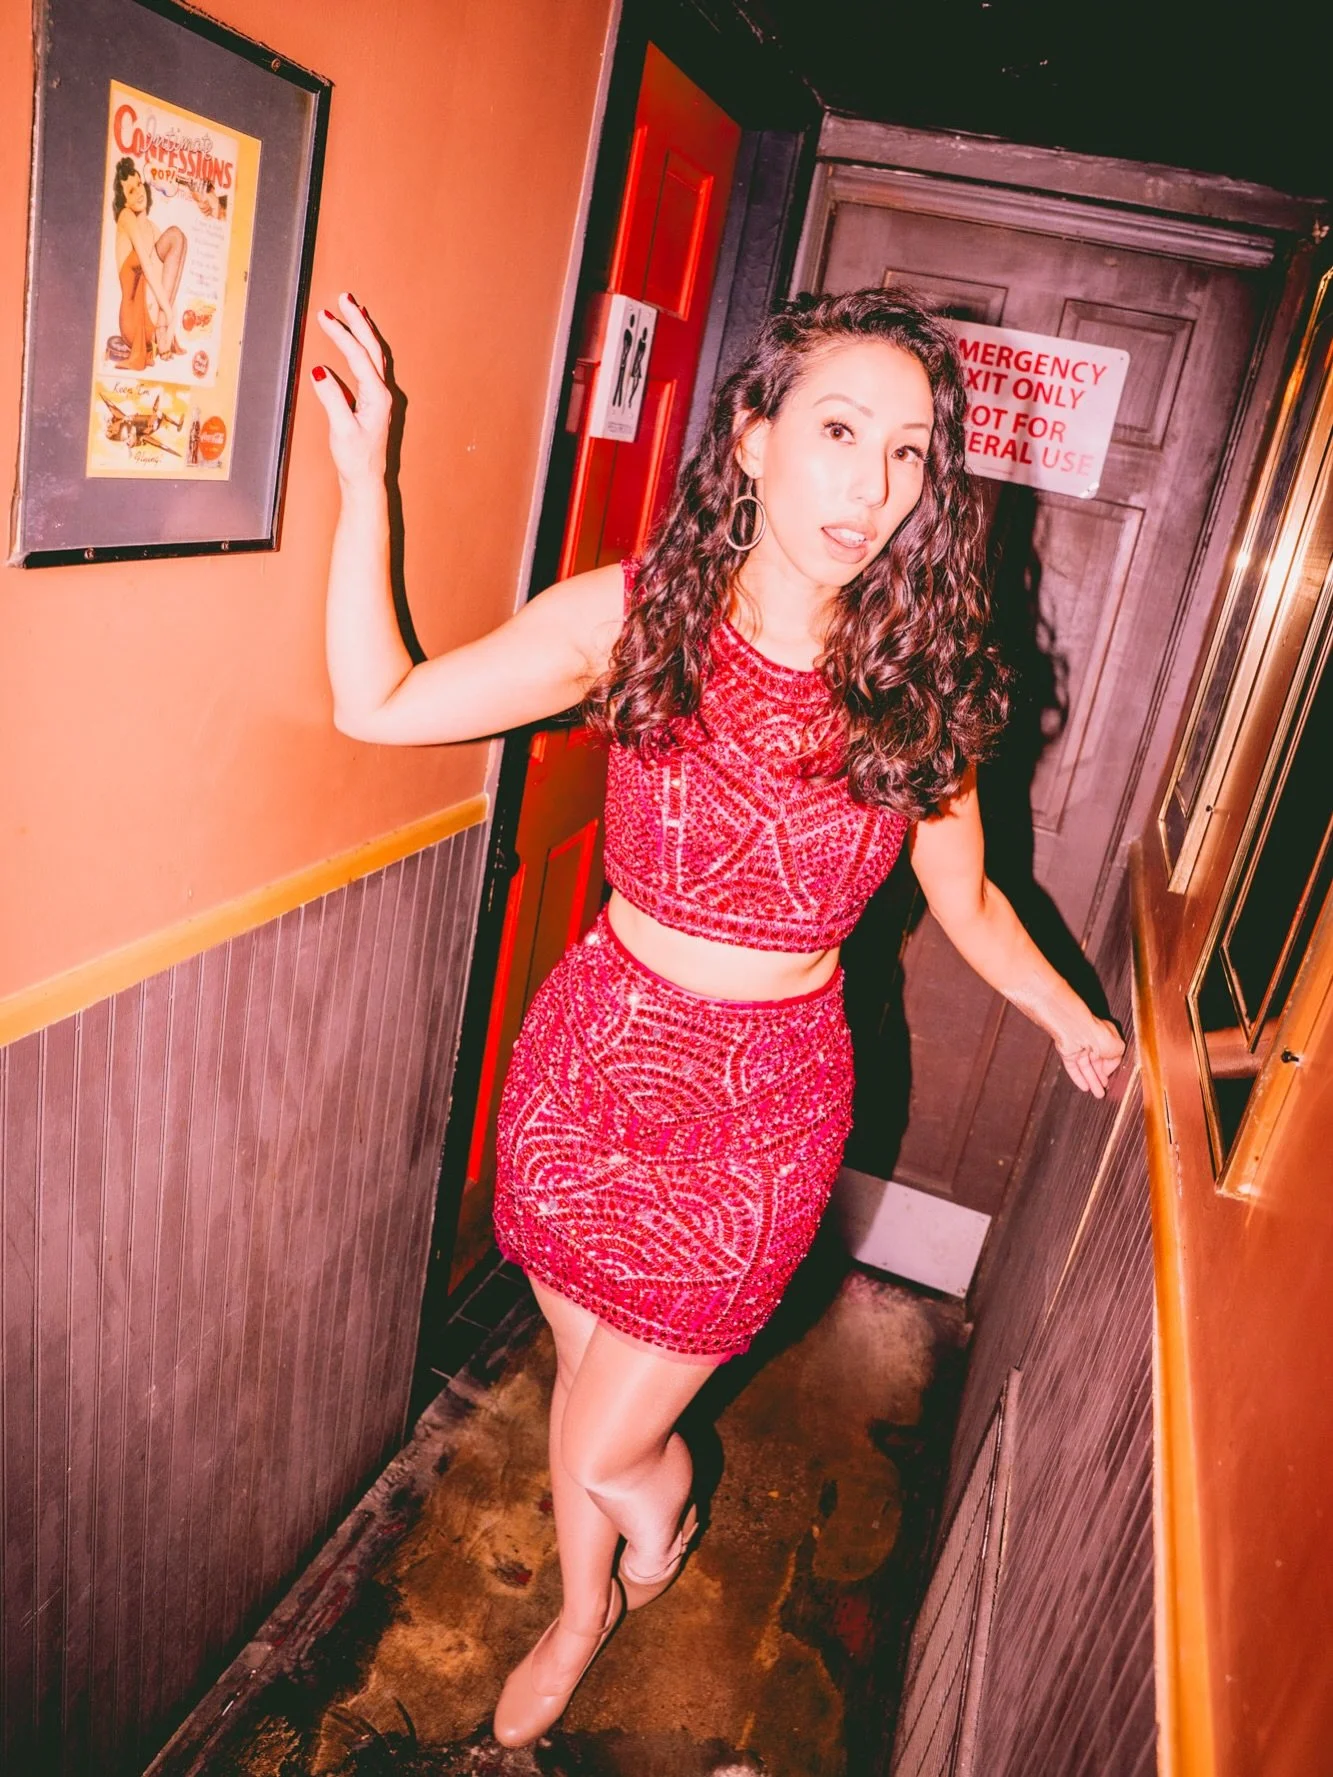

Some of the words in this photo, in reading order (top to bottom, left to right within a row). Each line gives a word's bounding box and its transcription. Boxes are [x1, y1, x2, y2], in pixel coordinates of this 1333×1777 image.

[150, 167, 175, 184] POP!
[959, 338, 1108, 386] MERGENCY
[963, 367, 1009, 395] XIT
[1012, 377, 1086, 410] ONLY
[1011, 412, 1067, 444] FOR
[967, 431, 1033, 466] ERAL
[1041, 446, 1096, 477] USE
